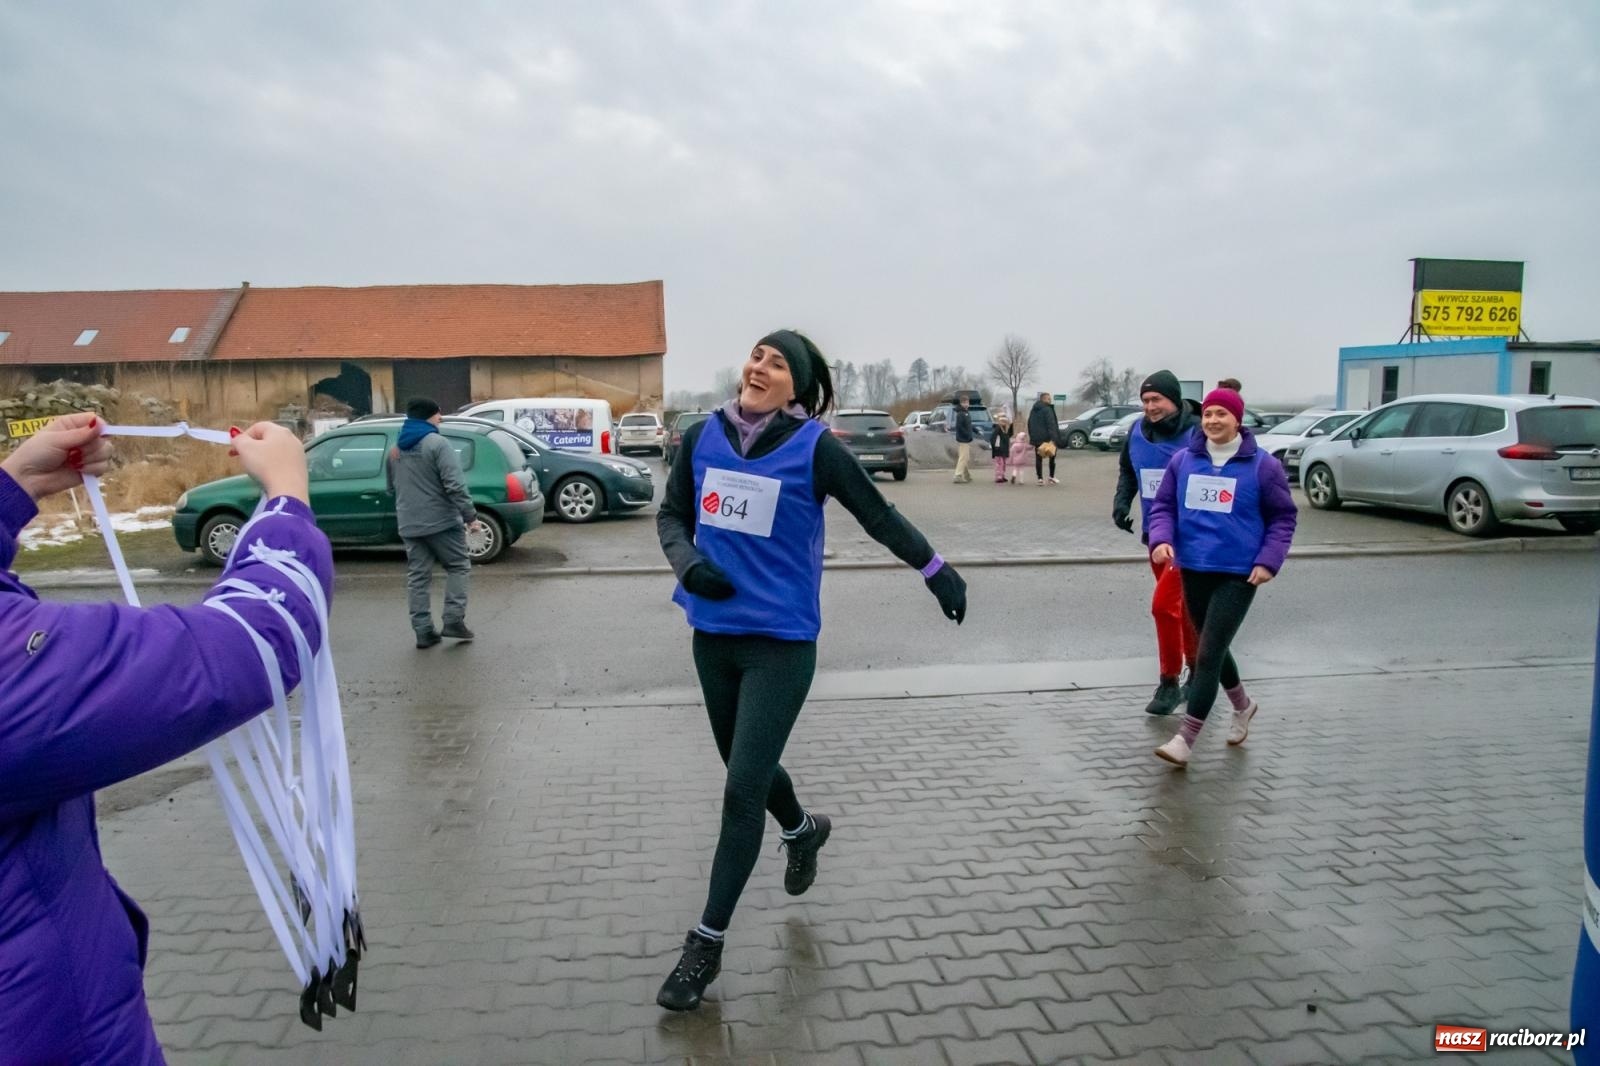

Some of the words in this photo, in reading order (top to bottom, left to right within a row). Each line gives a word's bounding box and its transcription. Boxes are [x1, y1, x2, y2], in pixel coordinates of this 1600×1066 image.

[1422, 305, 1450, 321] 575
[1456, 306, 1484, 322] 792
[1488, 306, 1518, 322] 626
[553, 433, 592, 445] Catering
[1199, 488, 1218, 502] 33
[721, 495, 749, 520] 64
